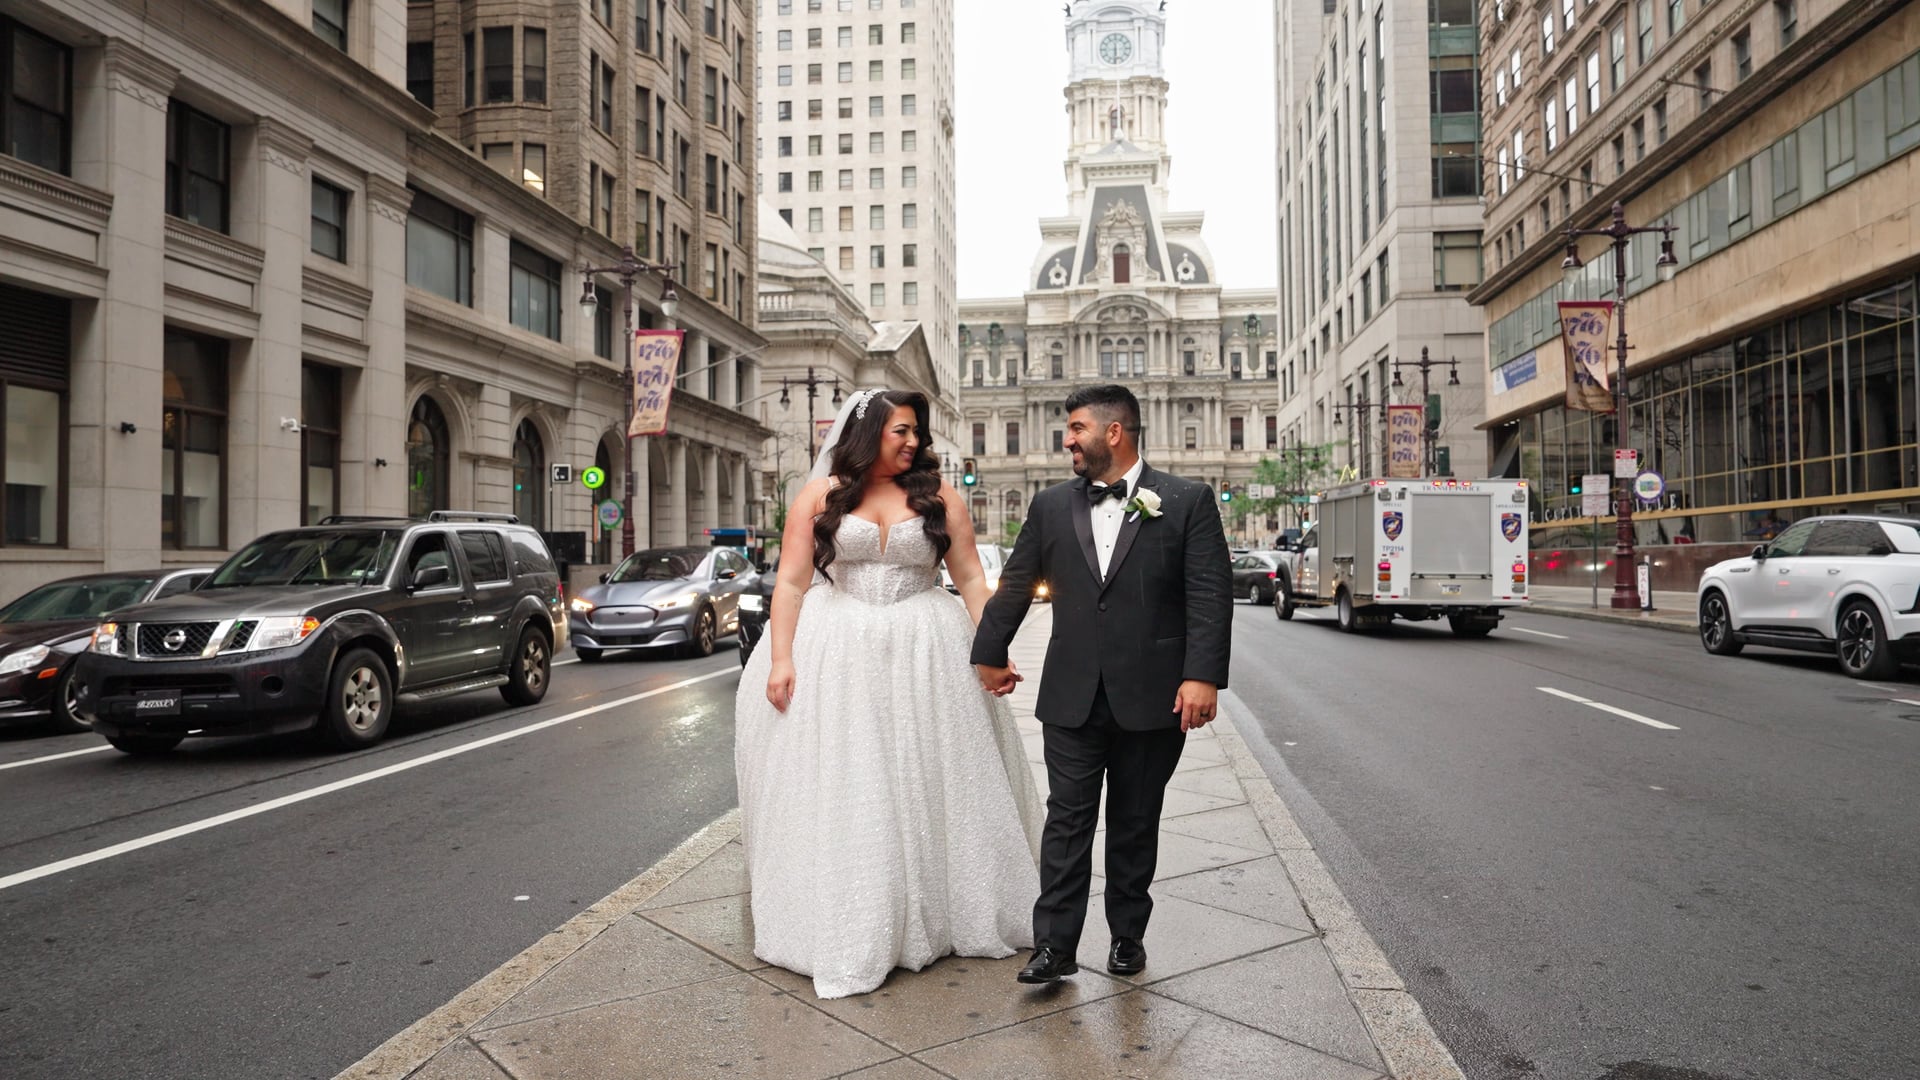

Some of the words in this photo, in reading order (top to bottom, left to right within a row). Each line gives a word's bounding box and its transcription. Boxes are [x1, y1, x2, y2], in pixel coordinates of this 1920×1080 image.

[639, 339, 674, 360] 1776
[1392, 411, 1418, 426] 1776
[1392, 430, 1417, 445] 1776
[1392, 448, 1417, 462] 1776
[1612, 493, 1678, 516] GILLE
